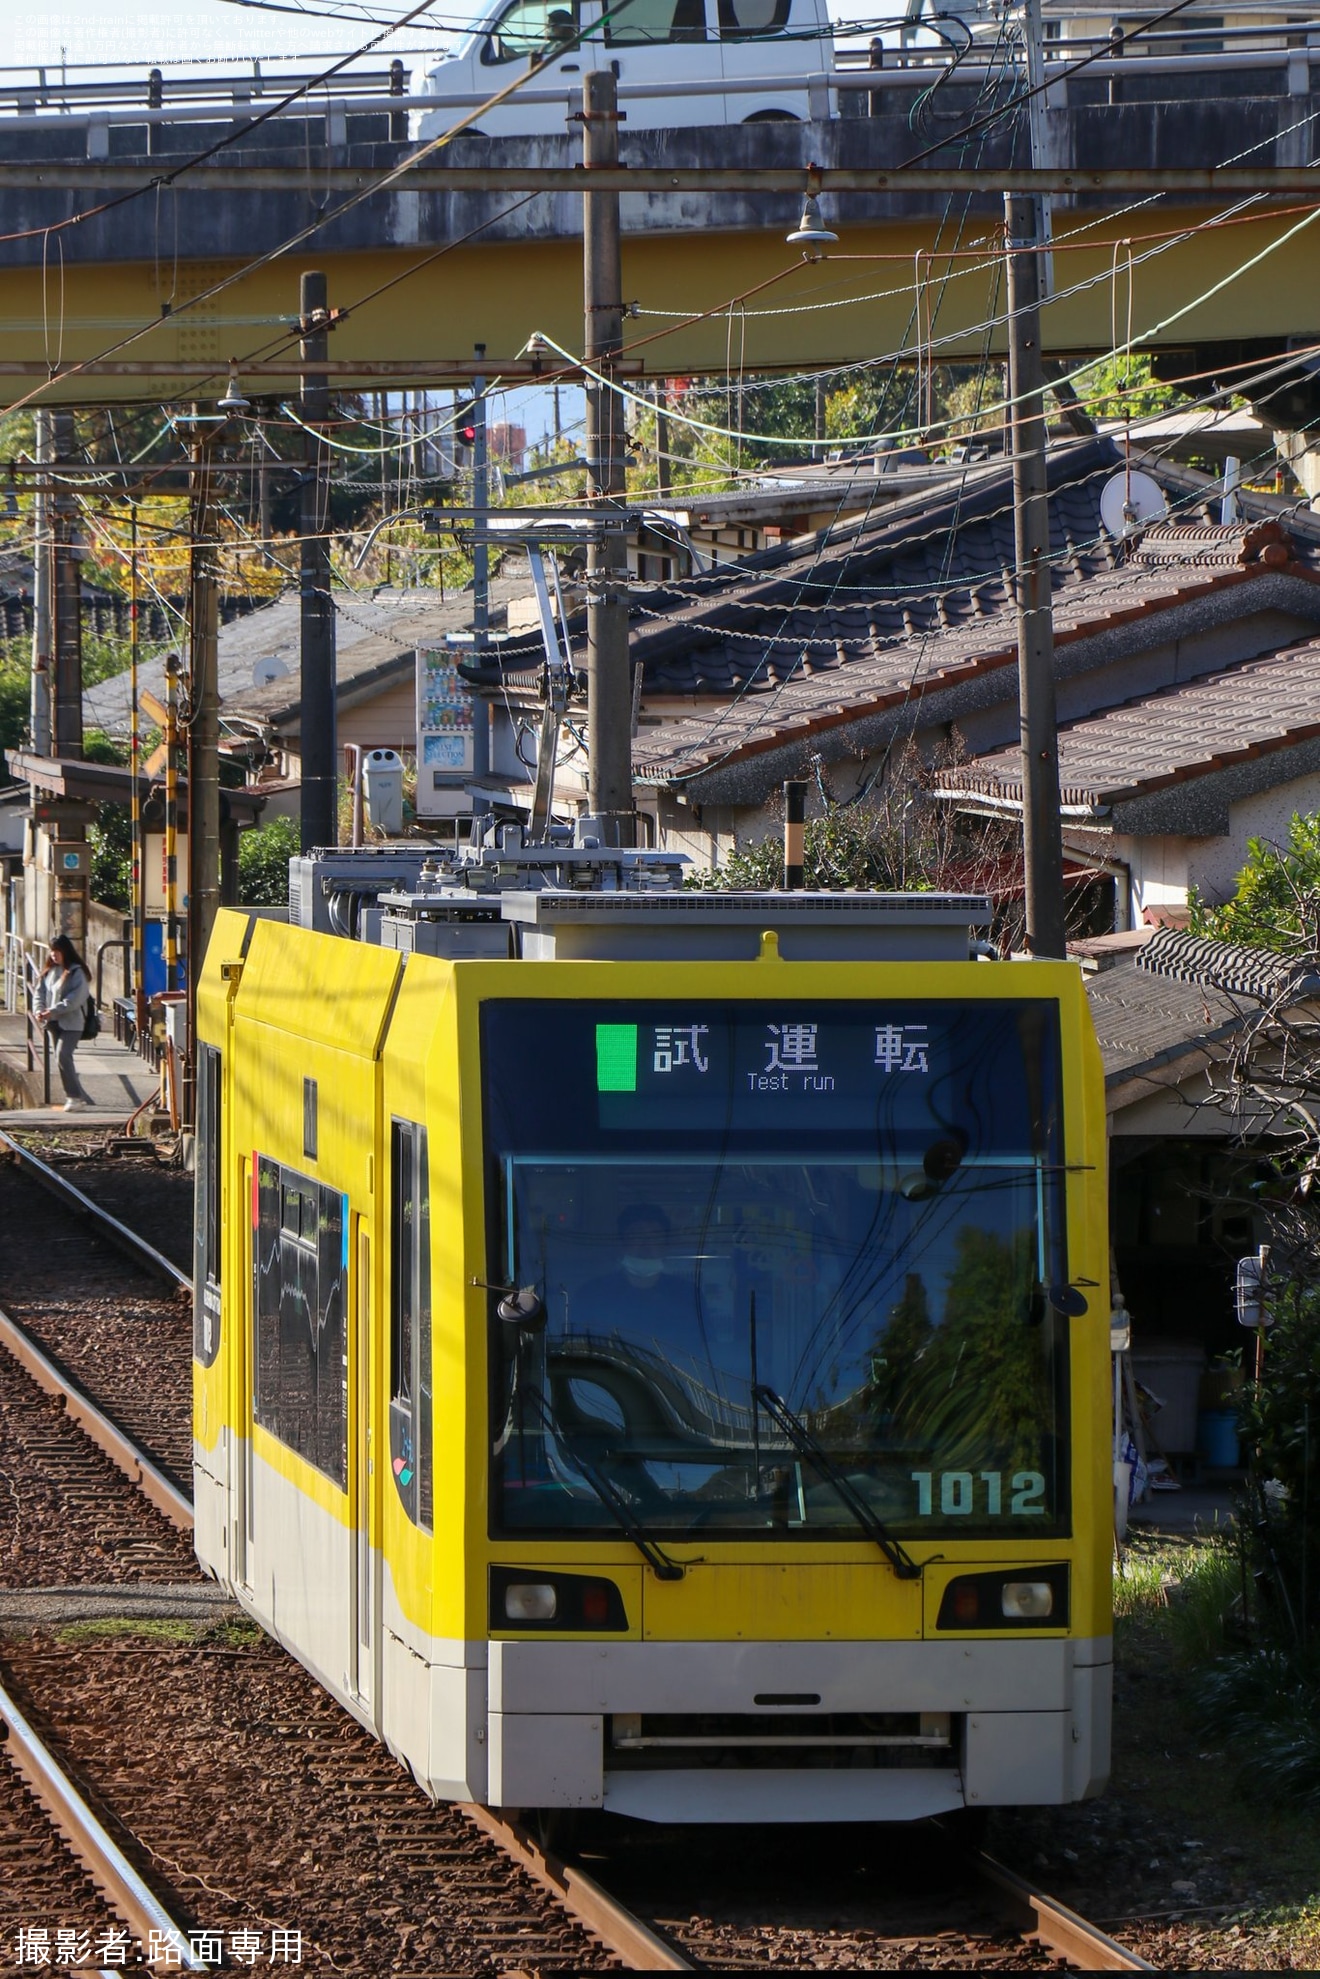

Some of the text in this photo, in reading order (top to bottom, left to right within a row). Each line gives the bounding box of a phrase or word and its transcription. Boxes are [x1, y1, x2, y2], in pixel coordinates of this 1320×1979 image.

[747, 1072, 835, 1091] Test run
[911, 1471, 1046, 1516] 1012
